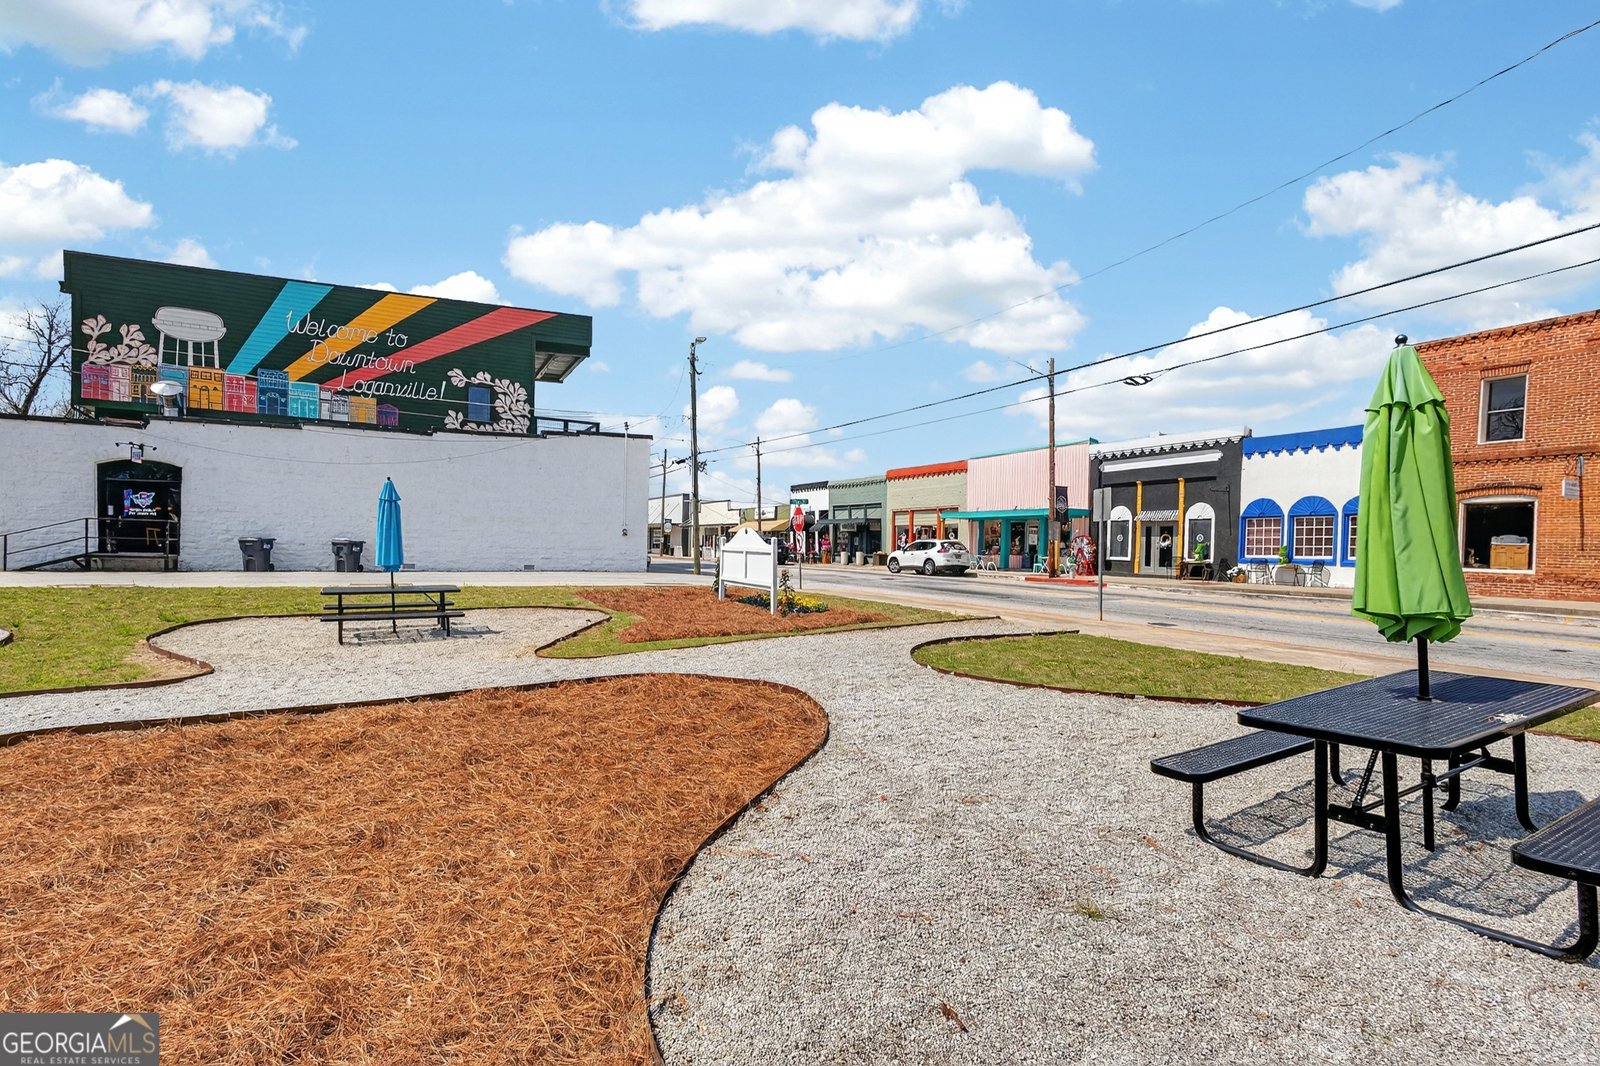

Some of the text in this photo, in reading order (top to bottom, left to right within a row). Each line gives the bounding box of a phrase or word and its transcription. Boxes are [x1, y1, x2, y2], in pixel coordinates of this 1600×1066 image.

[286, 310, 409, 348] Welcome to
[307, 339, 417, 374] Downtown
[337, 369, 447, 401] Loganville!
